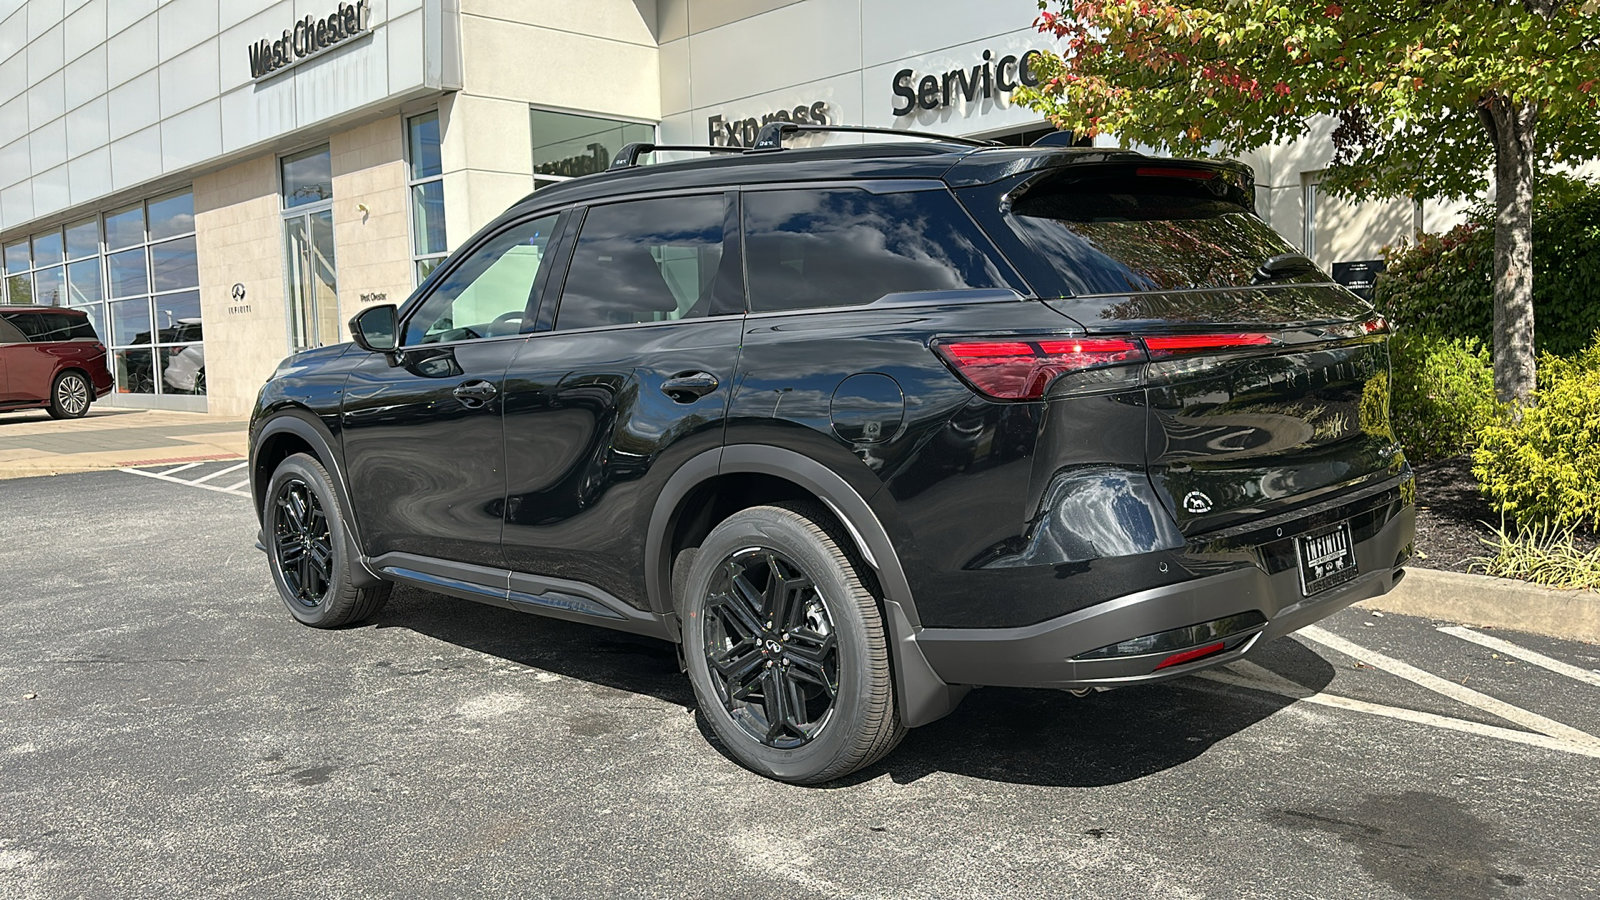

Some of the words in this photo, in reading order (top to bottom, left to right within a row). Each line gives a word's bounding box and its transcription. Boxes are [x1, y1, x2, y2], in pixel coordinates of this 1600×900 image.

[248, 28, 292, 78] West
[293, 0, 369, 58] Chester
[1305, 530, 1347, 561] INFINITI
